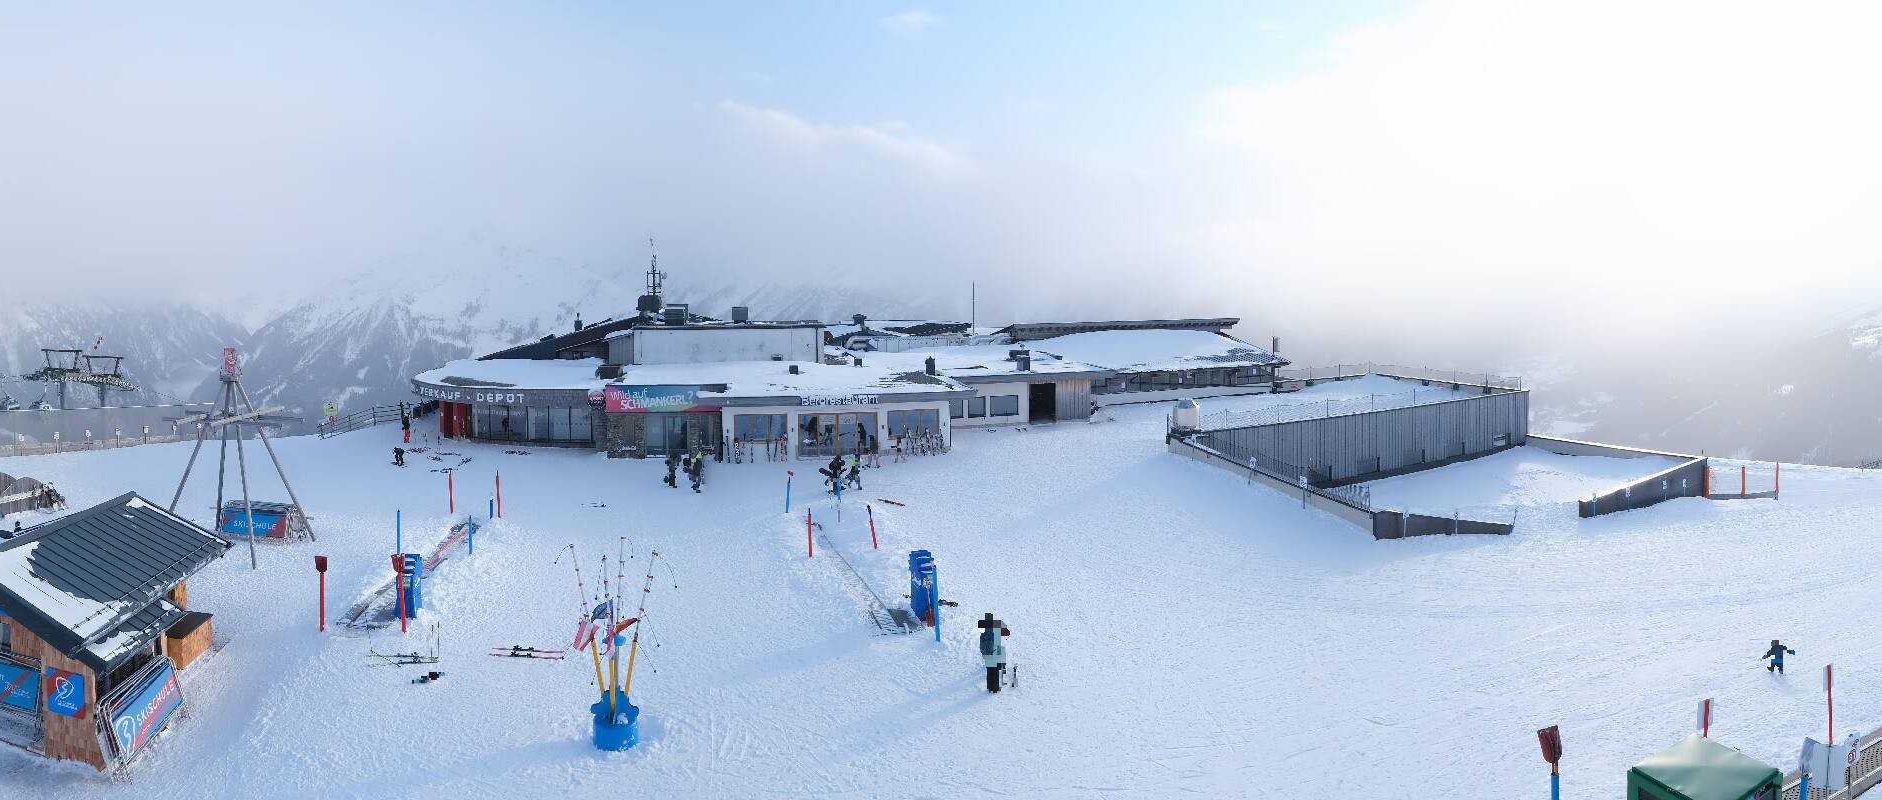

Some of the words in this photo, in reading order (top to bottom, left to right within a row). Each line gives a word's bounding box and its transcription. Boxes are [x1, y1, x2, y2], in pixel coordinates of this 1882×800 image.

[476, 392, 525, 404] DEPOT
[610, 389, 631, 400] Wild
[633, 387, 648, 399] auf
[620, 391, 694, 410] SCHMANKERL?
[233, 520, 277, 530] SKICHULE
[135, 680, 175, 727] SKISCHULE
